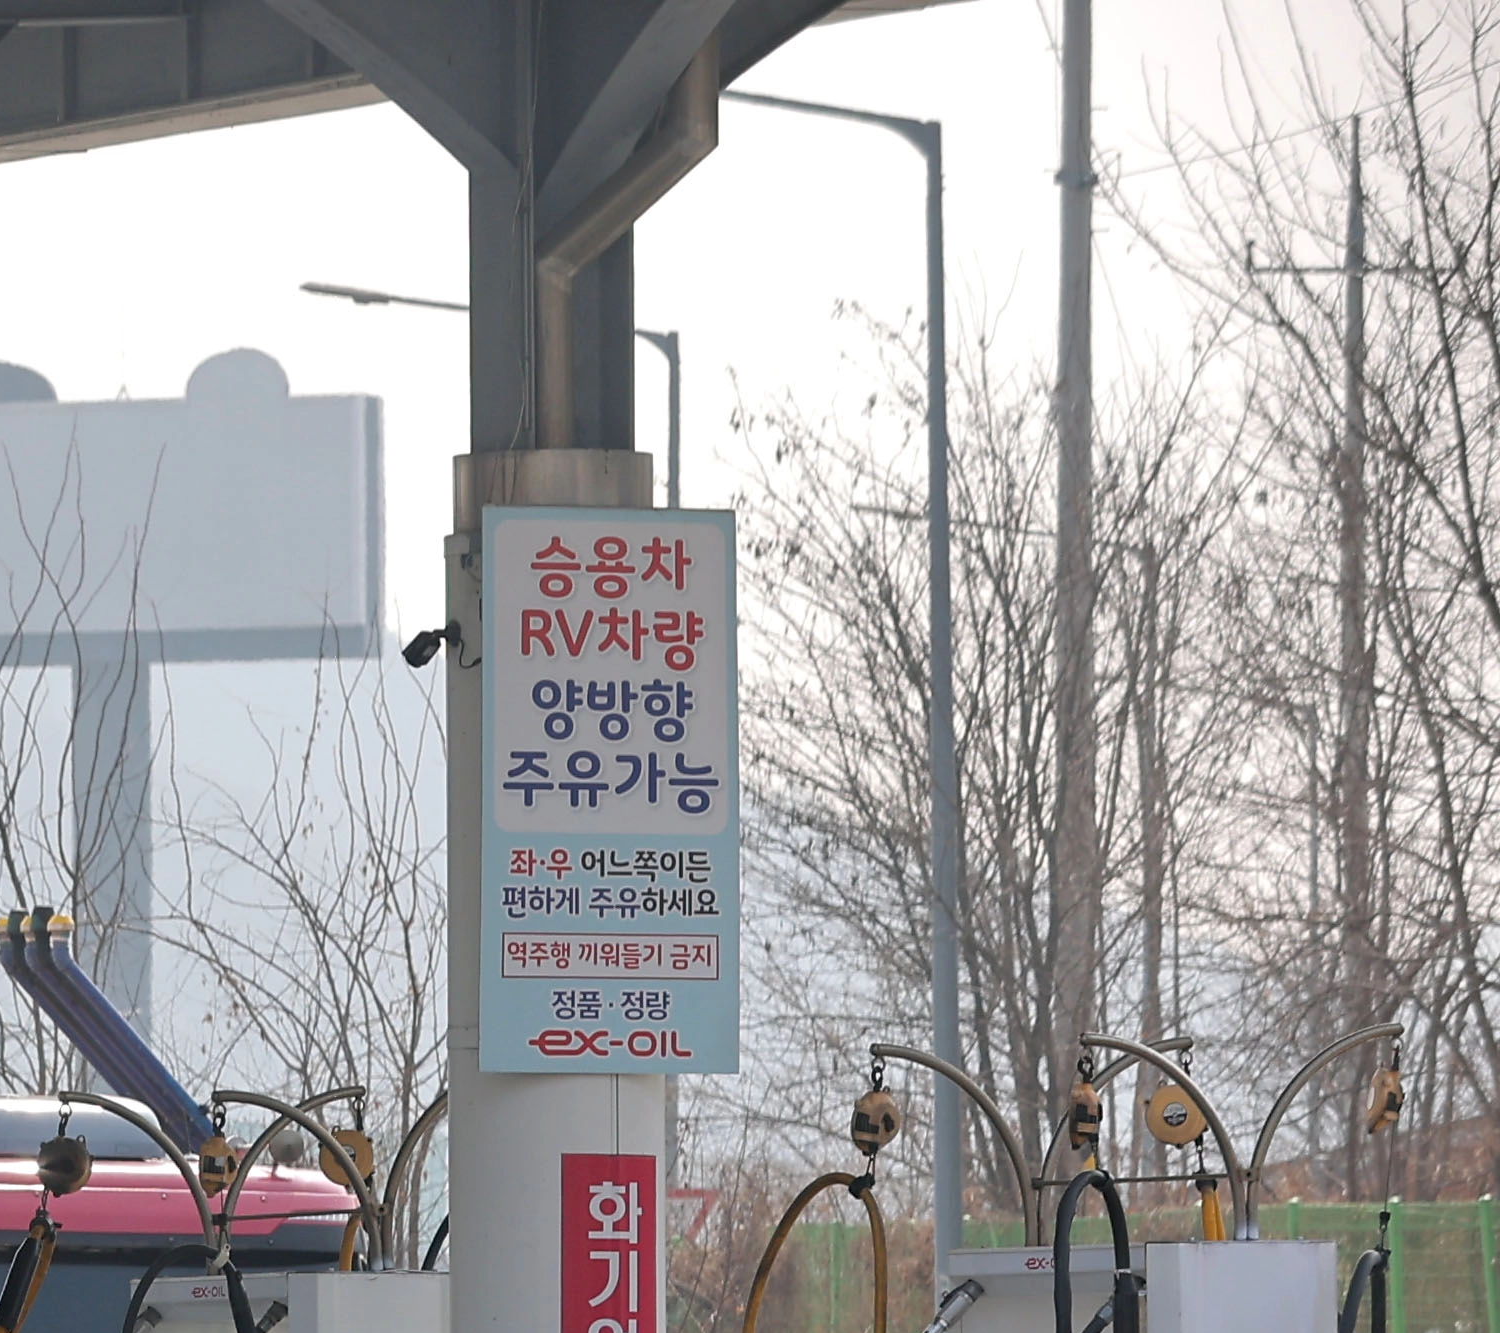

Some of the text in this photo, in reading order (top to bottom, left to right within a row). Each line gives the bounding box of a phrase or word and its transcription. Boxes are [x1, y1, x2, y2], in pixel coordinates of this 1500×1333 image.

[529, 535, 692, 599] 승용차
[520, 607, 705, 672] RV차량
[530, 677, 694, 742] 양방향
[502, 751, 720, 815] 주유가능
[508, 848, 713, 884] 좌·우 어느쪽이든
[501, 885, 720, 919] 편하게 주유하세요
[506, 940, 713, 970] 역주행 끼워들기 금지
